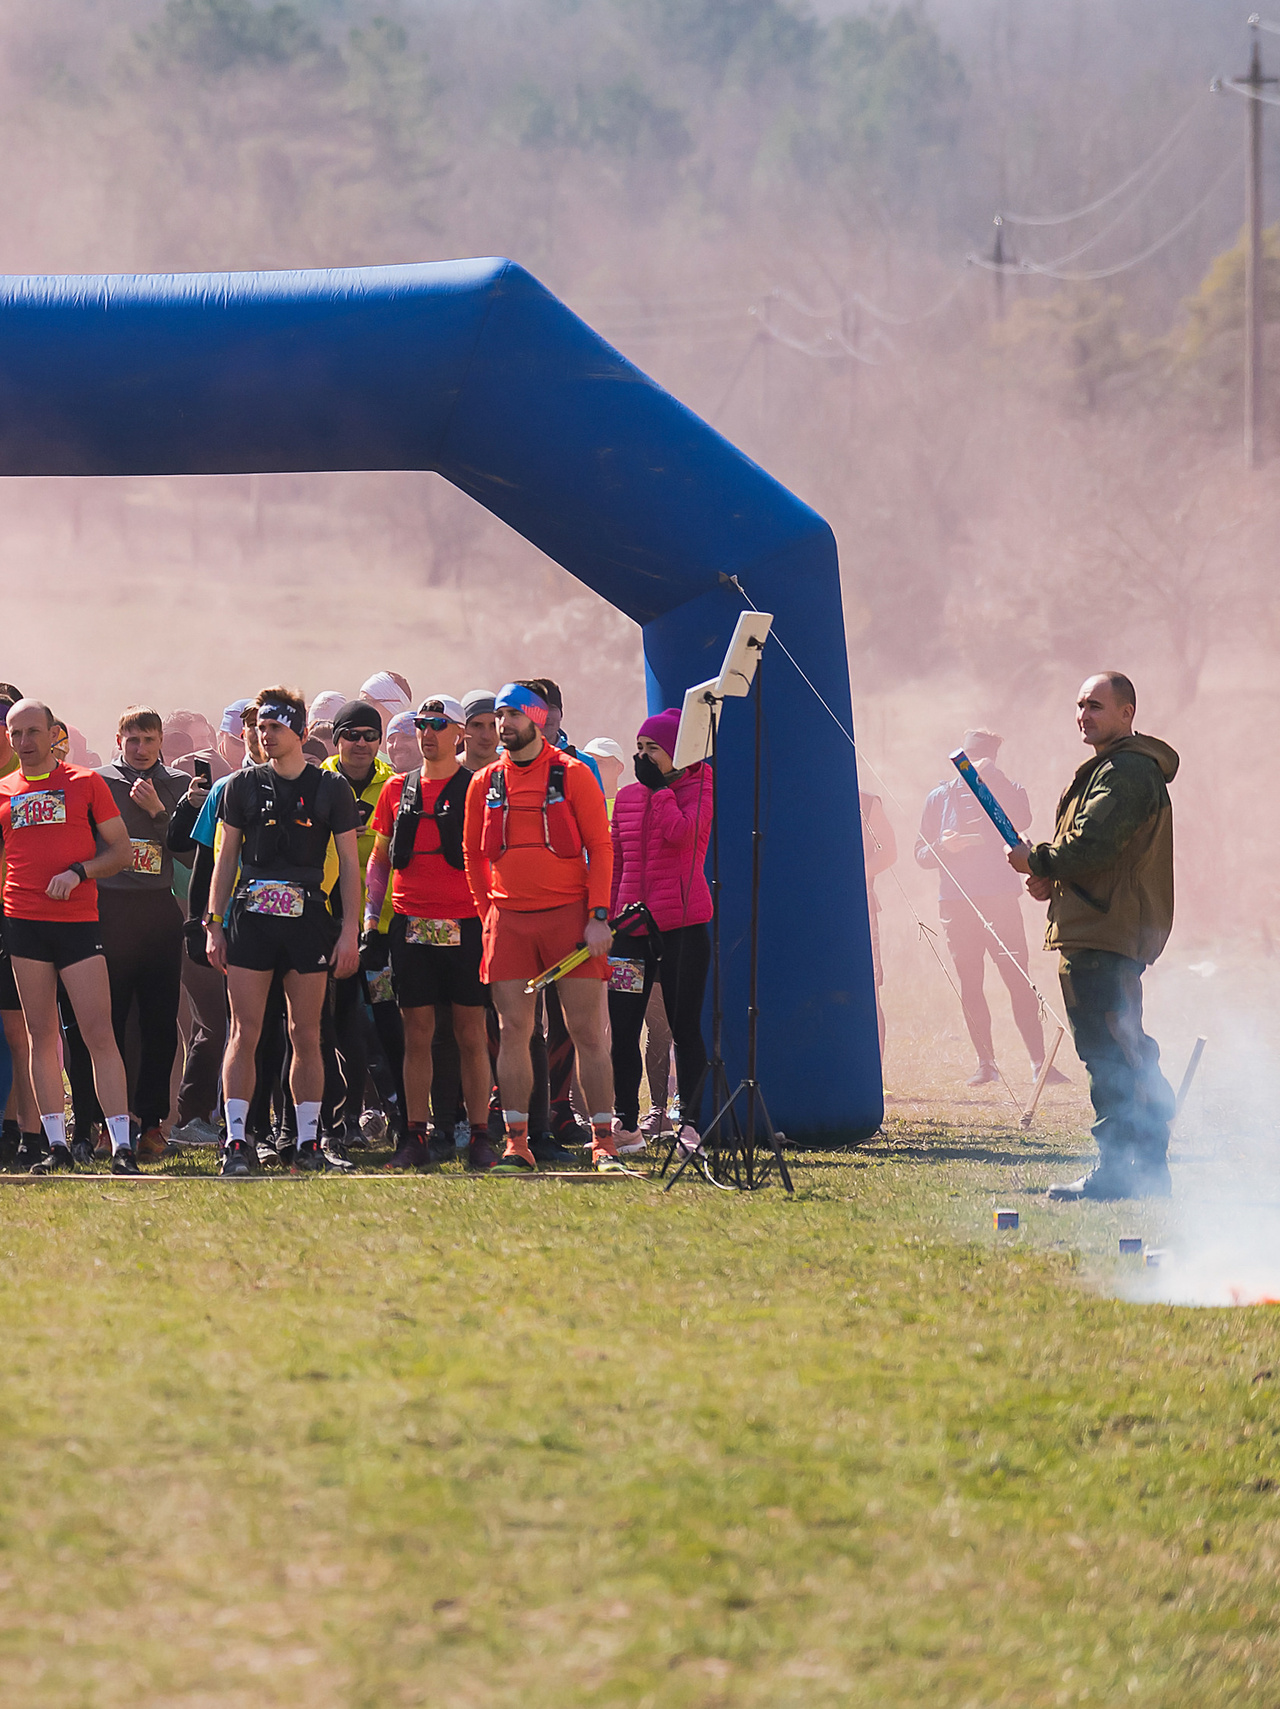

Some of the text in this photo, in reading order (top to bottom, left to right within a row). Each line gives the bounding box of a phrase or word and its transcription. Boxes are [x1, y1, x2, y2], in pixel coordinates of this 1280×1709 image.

[23, 800, 54, 824] 105
[133, 849, 151, 871] 14
[608, 967, 633, 989] 55
